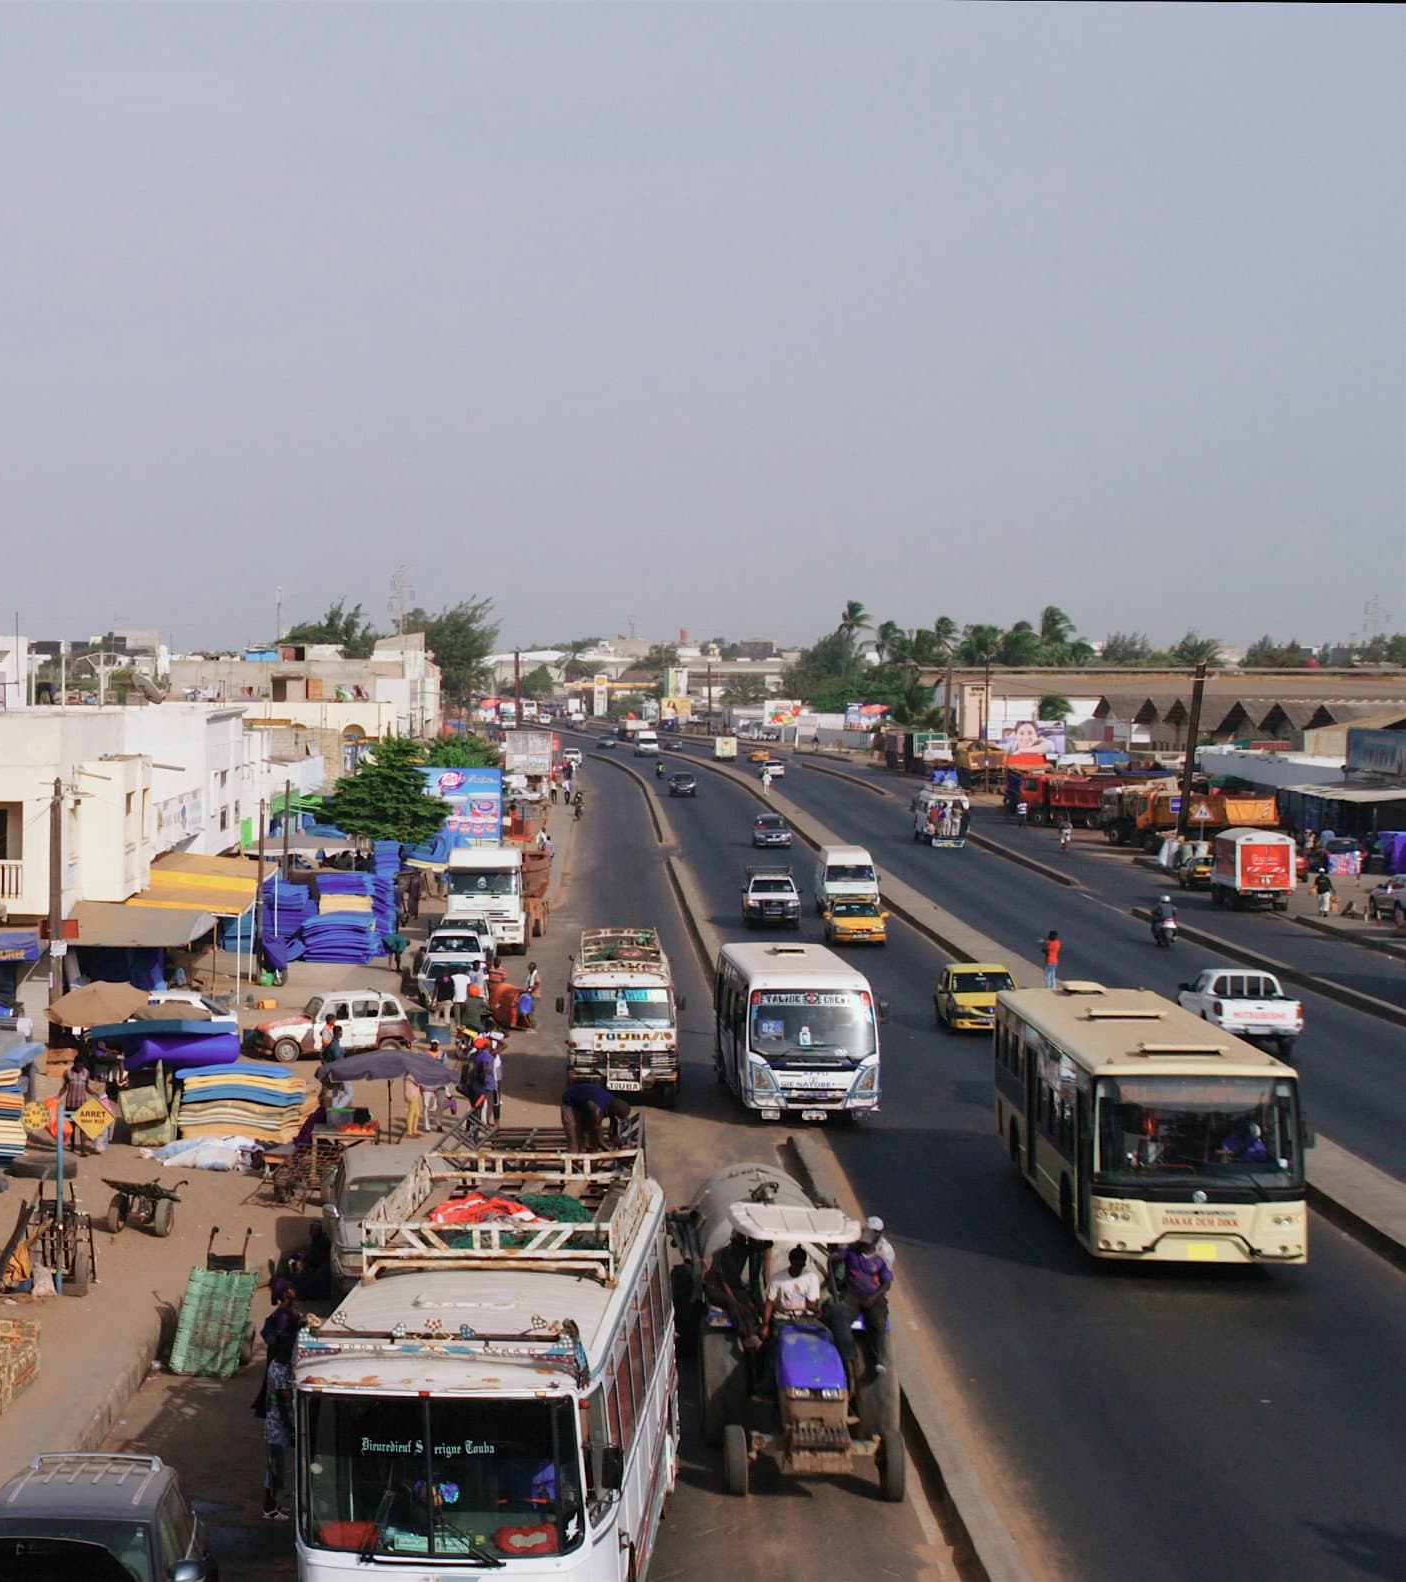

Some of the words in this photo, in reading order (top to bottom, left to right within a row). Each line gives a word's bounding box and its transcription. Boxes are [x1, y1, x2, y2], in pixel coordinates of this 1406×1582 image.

[594, 1032, 651, 1041] TOUBA
[80, 1110, 106, 1118] ARRET
[1162, 1215, 1195, 1227] DAKAR
[464, 1439, 495, 1455] Touba
